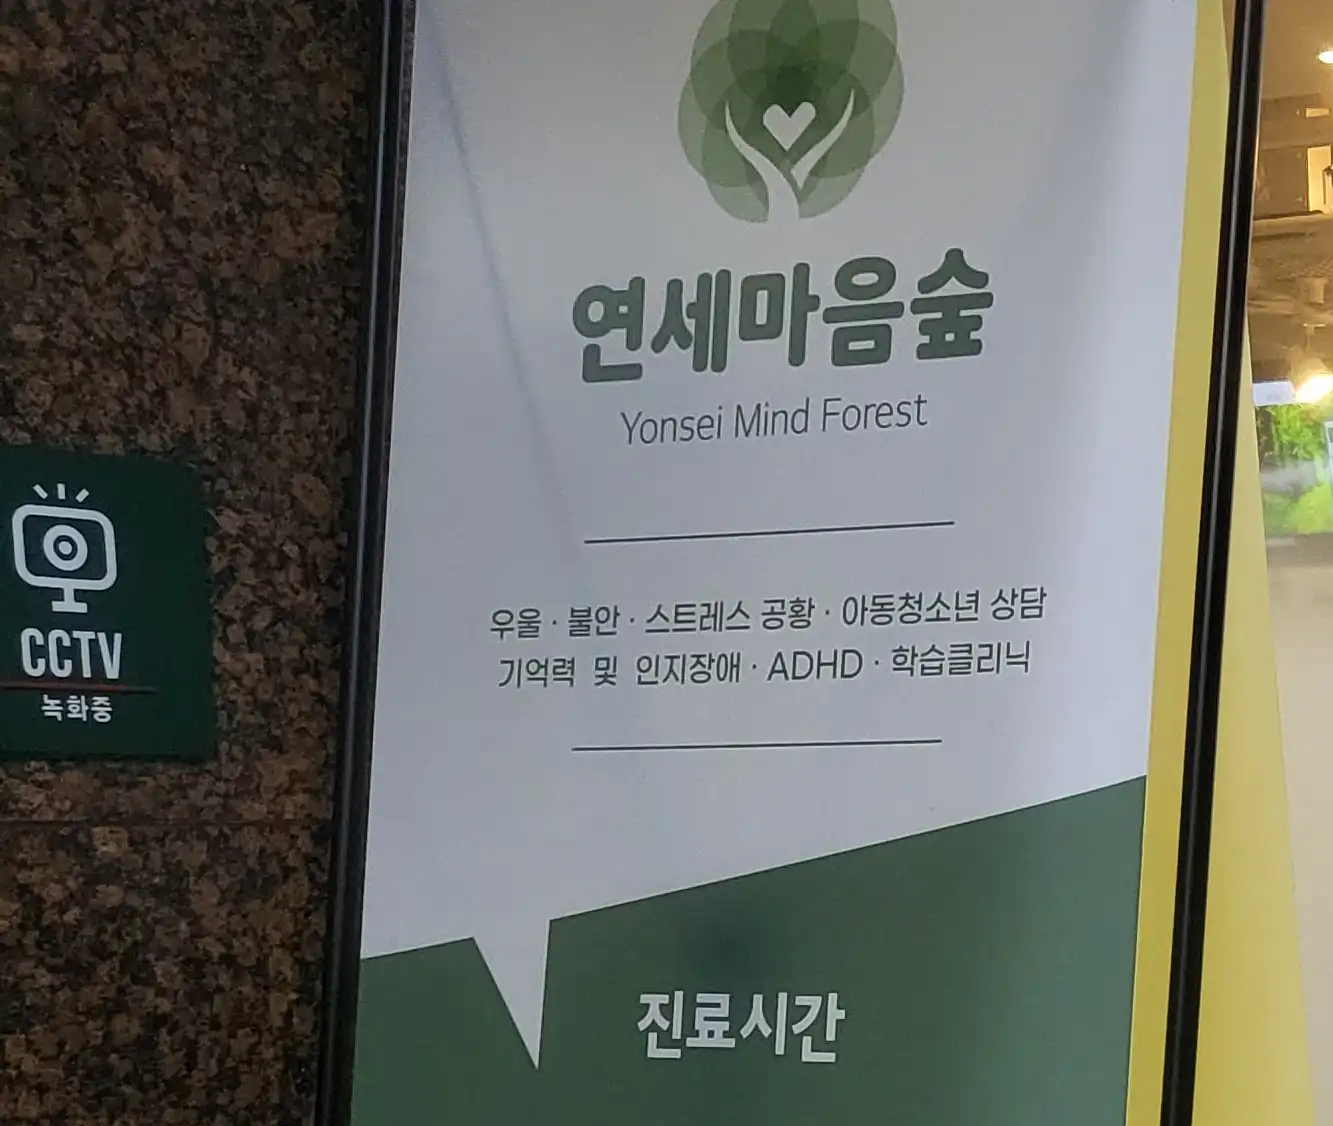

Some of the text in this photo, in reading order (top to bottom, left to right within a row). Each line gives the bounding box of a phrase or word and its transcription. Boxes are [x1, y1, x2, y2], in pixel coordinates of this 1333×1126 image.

[573, 248, 993, 383] 연세마음숲
[621, 395, 927, 444] Yonsei Mind Forest
[491, 587, 1047, 639] 우울 불안 스트레스 공황 아동청소년 상담
[21, 628, 121, 678] CCTV
[499, 641, 1029, 688] 기억력 및 인지장애 ADHD 학습클리닉
[42, 695, 112, 722] 녹화중
[638, 991, 845, 1062] 진료시간
